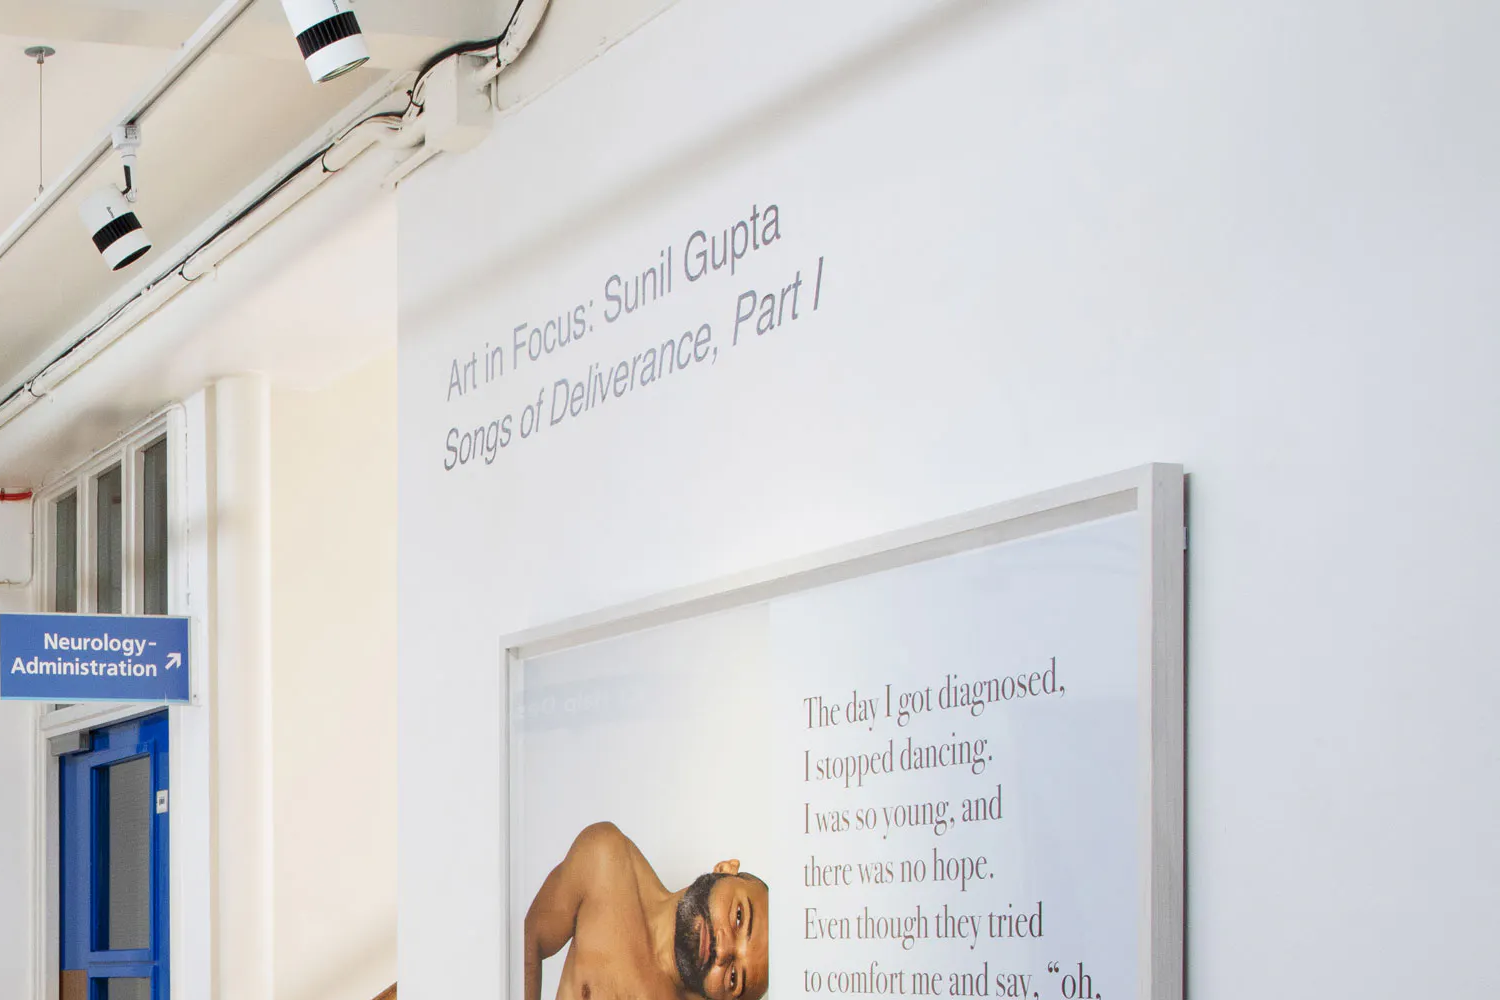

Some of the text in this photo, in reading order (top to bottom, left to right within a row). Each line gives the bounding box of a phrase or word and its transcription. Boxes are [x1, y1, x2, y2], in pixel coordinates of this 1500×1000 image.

[447, 204, 781, 401] Art in Focus: Sunil Gupta
[444, 256, 824, 472] Songs of Deliverance, Part I
[11, 657, 158, 677] Administration
[43, 632, 157, 656] Neurology-
[804, 656, 1065, 731] The day I got diagnosed,
[804, 732, 993, 788] I stopped dancing.
[804, 784, 1003, 839] I was so young, and
[804, 848, 994, 892] there was no hope.
[804, 901, 1044, 950] Even though they tried
[804, 967, 821, 992] to
[827, 961, 905, 995] comfort
[911, 971, 943, 995] me
[949, 962, 989, 998] and
